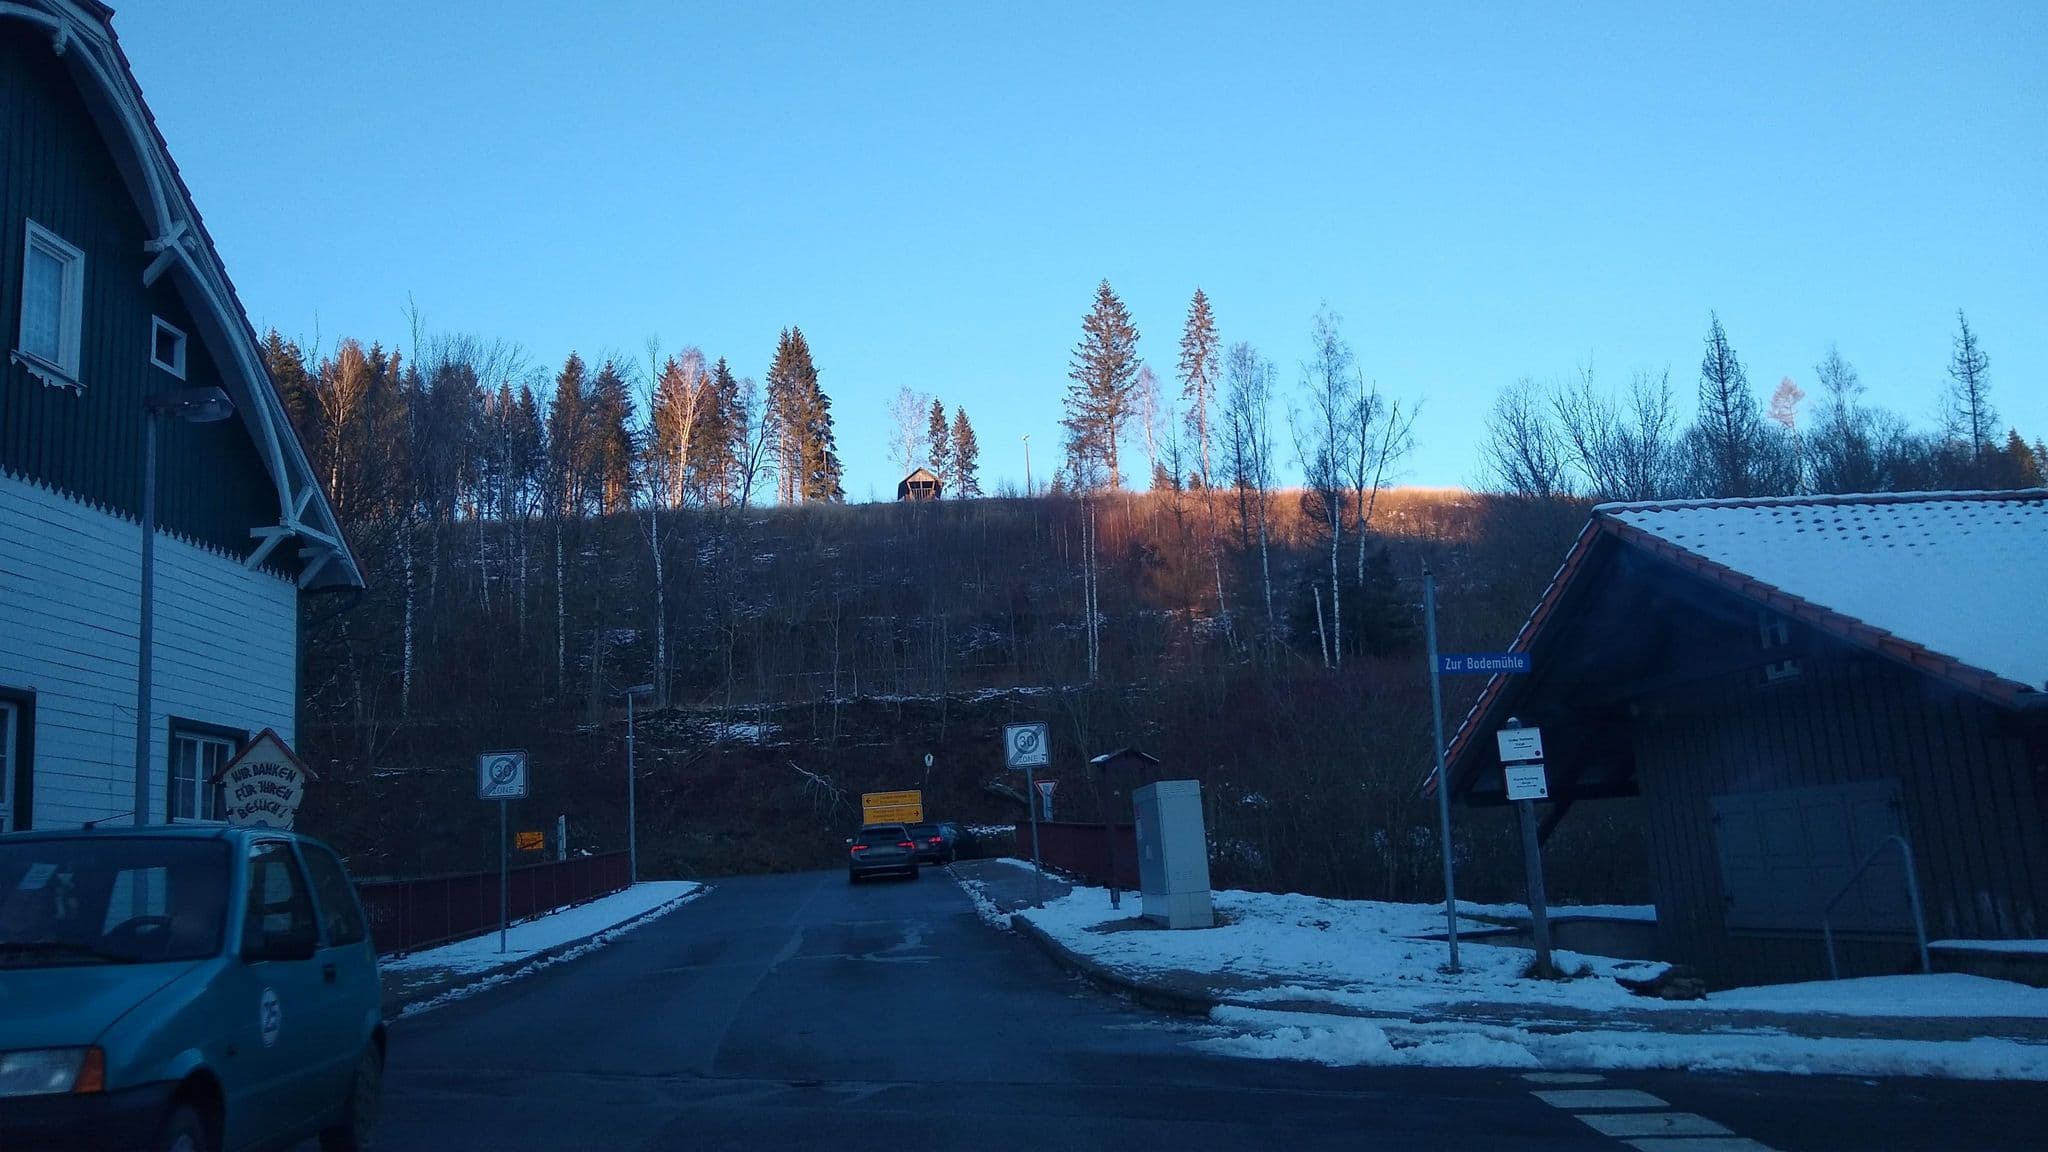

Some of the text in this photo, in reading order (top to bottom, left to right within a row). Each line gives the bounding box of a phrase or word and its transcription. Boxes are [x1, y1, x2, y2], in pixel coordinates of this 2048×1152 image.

[1445, 655, 1524, 670] Zur Bodemühle
[1019, 735, 1035, 748] 30
[231, 763, 297, 783] WIR DANKEN
[494, 765, 512, 778] 30
[235, 782, 257, 800] FÜR
